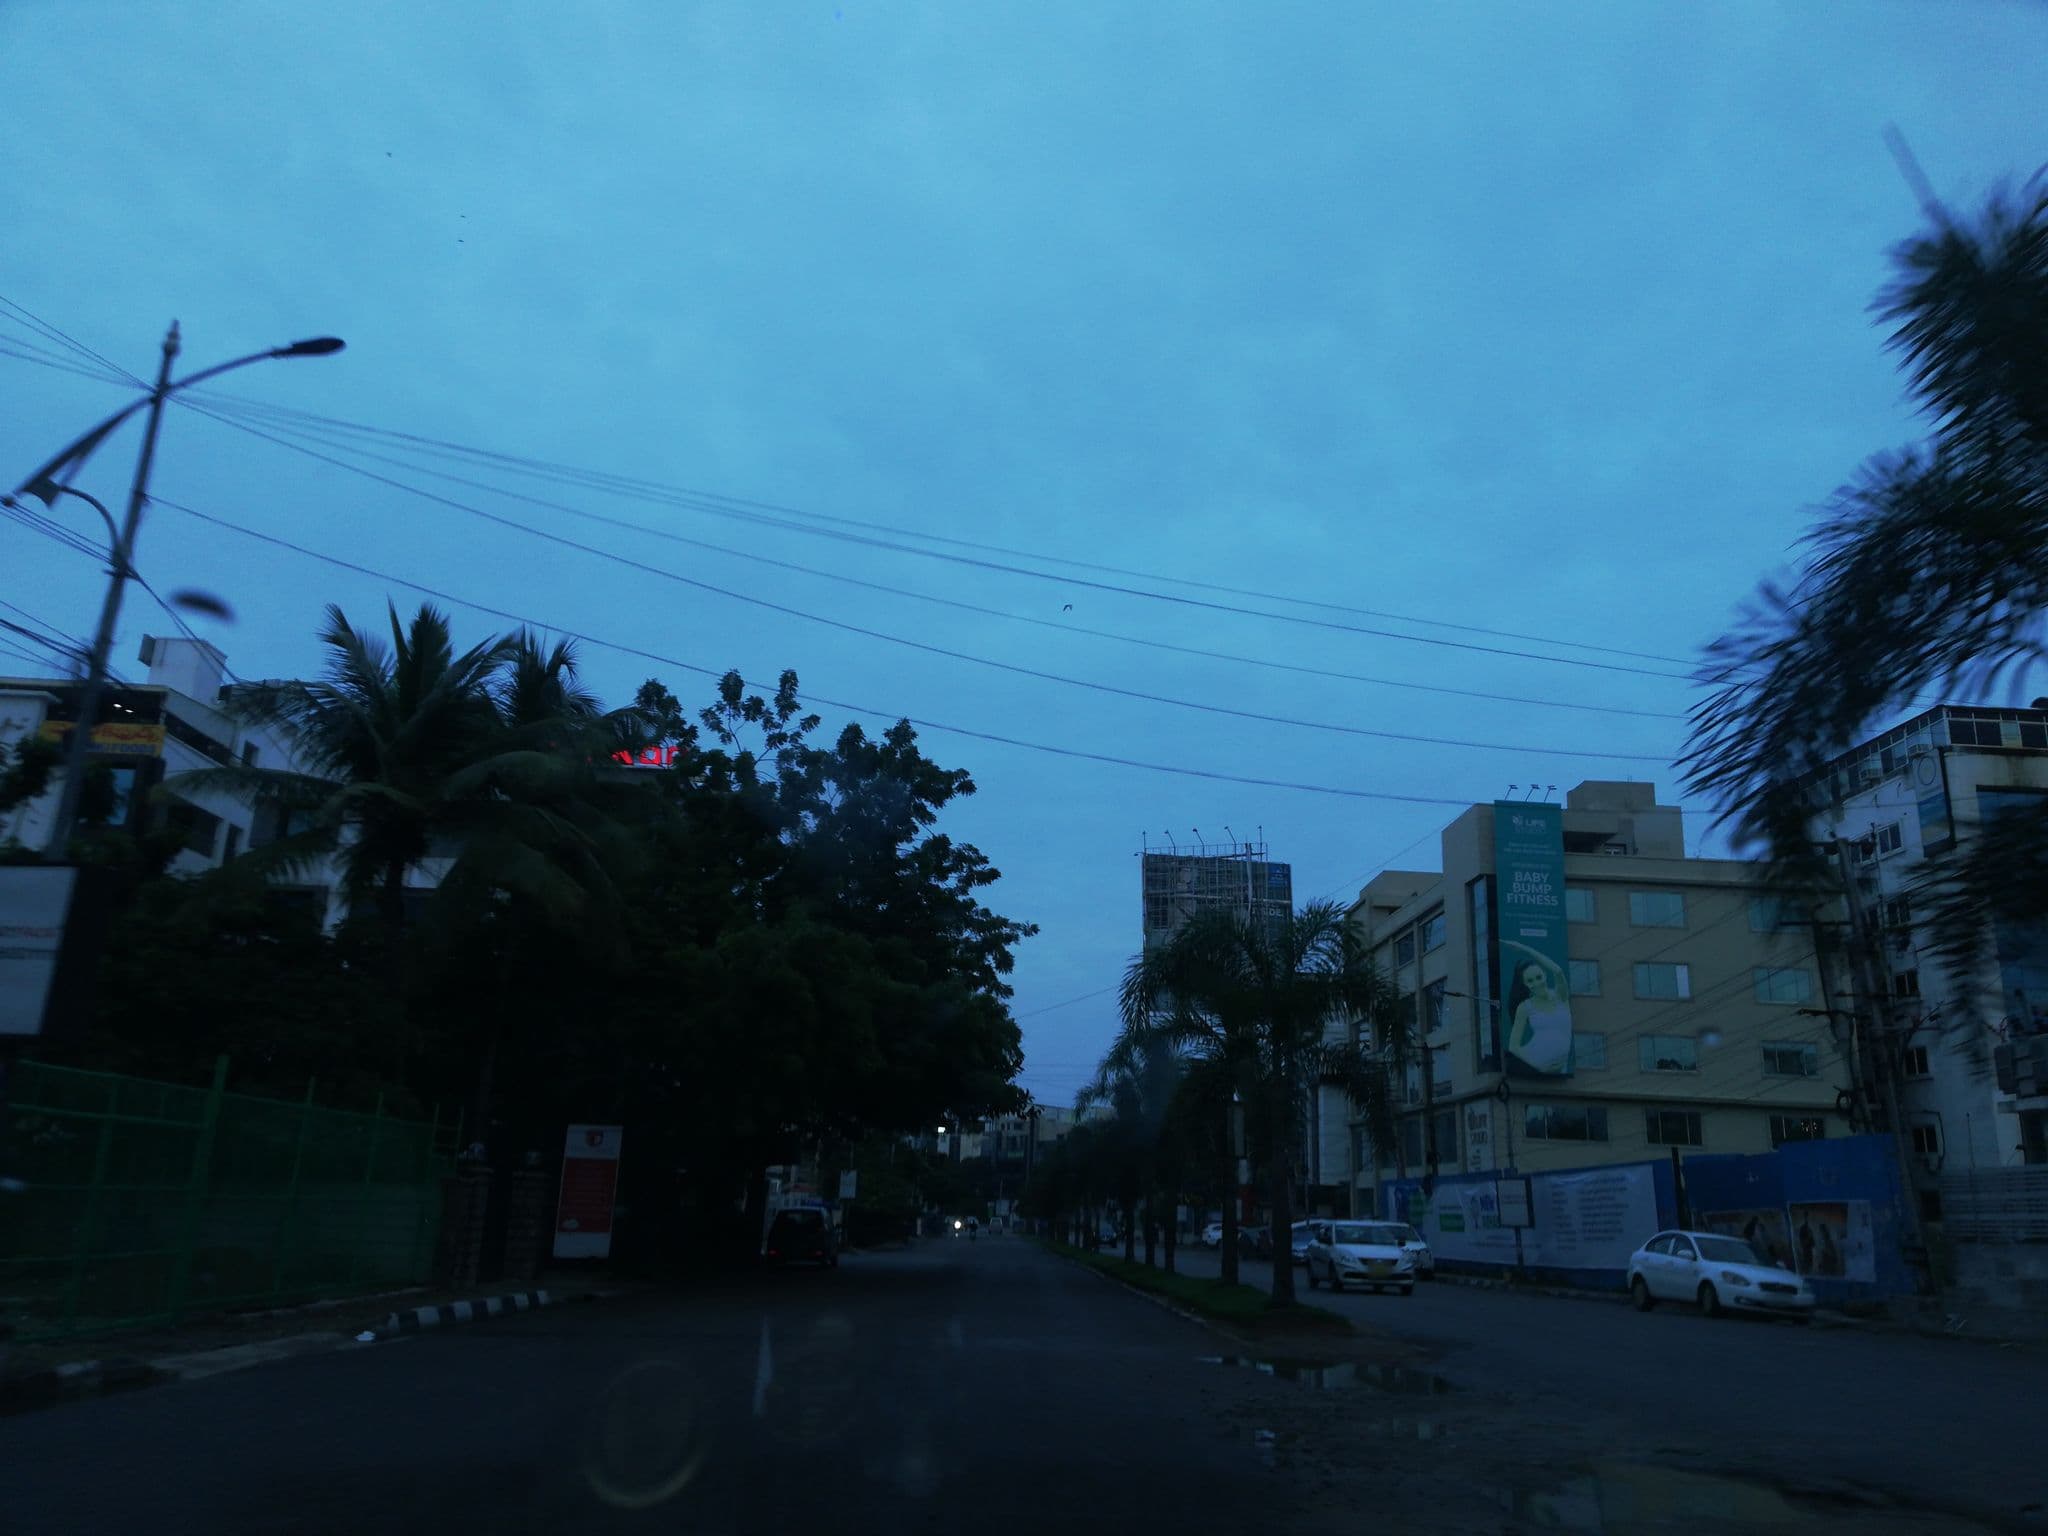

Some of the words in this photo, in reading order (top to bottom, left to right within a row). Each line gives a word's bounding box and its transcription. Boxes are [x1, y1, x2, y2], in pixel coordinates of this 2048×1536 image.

[1514, 871, 1550, 883] BABY
[1512, 882, 1552, 895] BUMP
[1507, 893, 1559, 906] FITNESS
